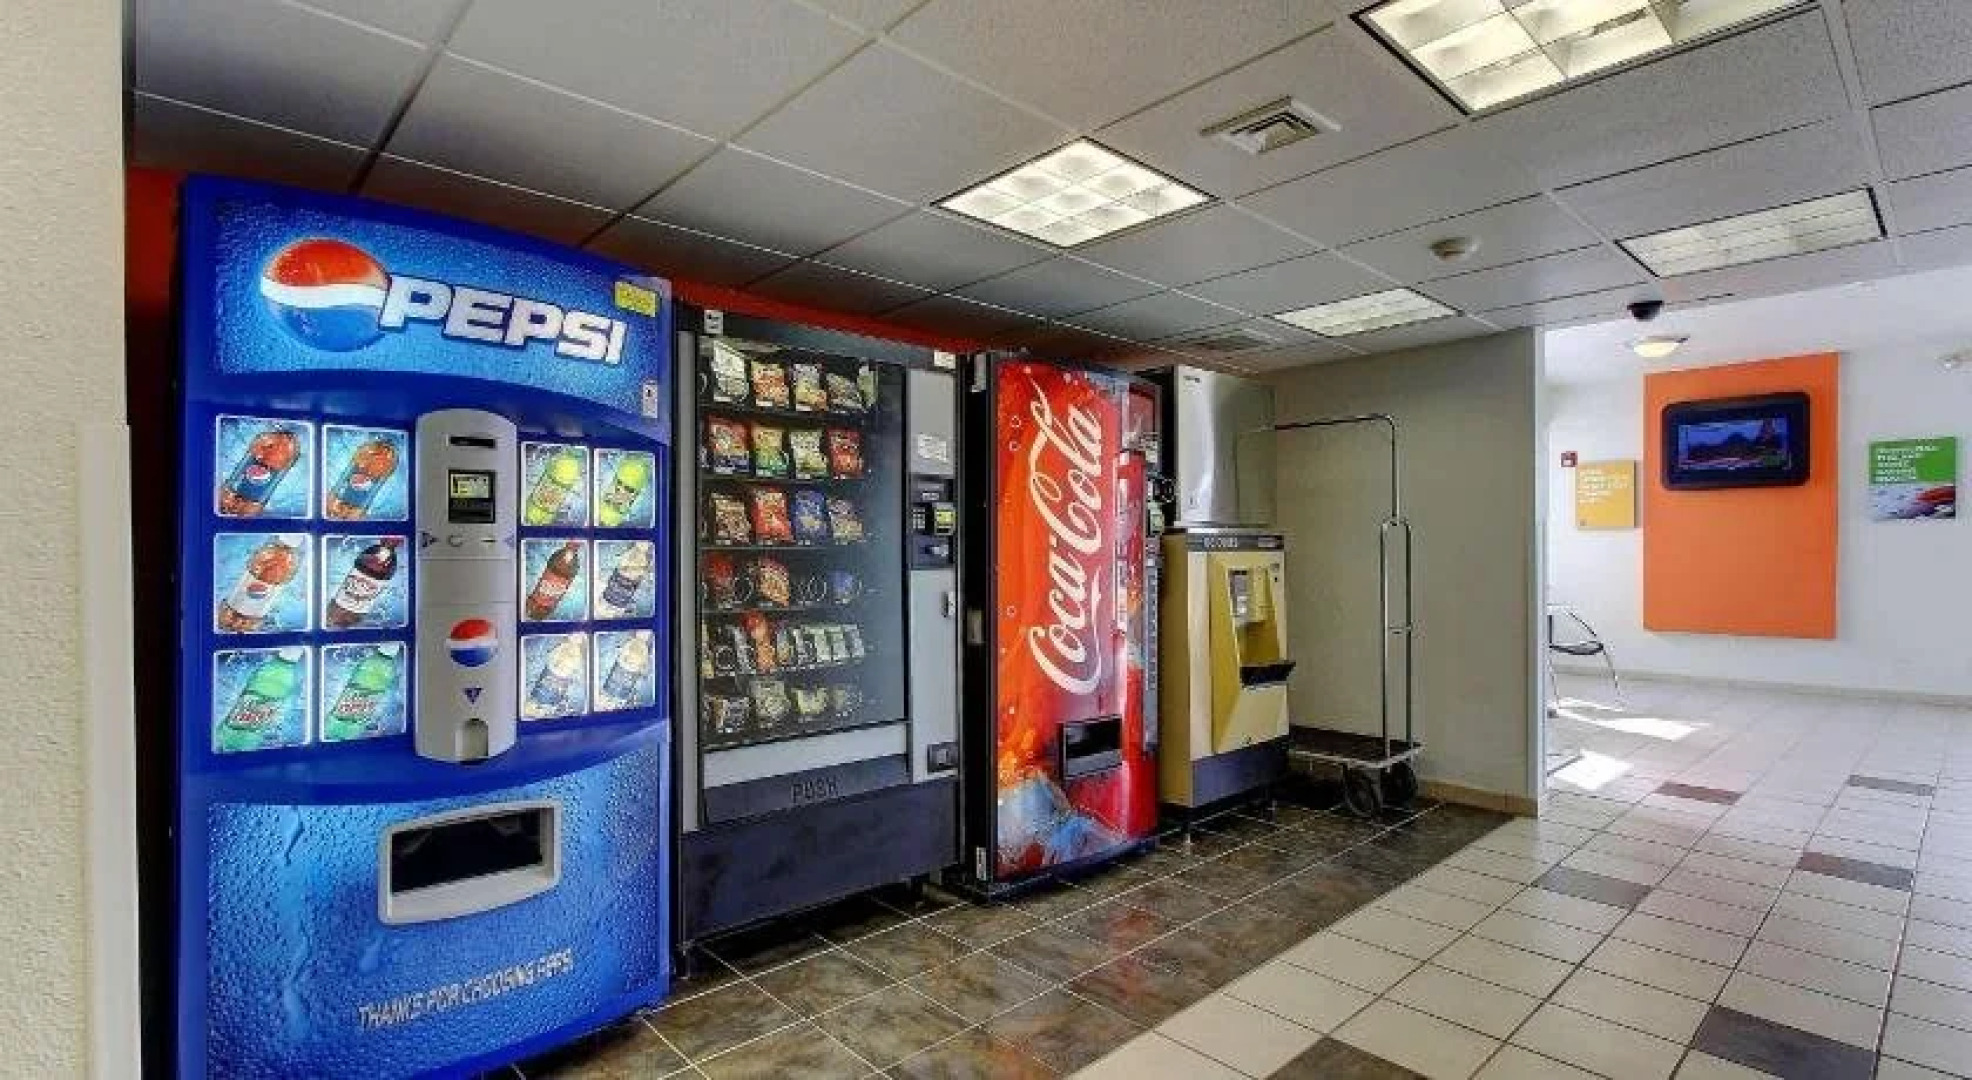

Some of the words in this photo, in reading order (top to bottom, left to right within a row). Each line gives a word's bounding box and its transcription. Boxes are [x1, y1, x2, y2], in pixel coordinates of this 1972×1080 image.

[379, 273, 628, 365] PEPSI
[1028, 376, 1102, 693] Coca-Cola
[792, 776, 839, 804] PUSH
[358, 992, 423, 1027] THANKS
[426, 982, 463, 1012] FOR
[464, 961, 534, 1003] CHOOSING
[536, 947, 573, 981] PEPSI
